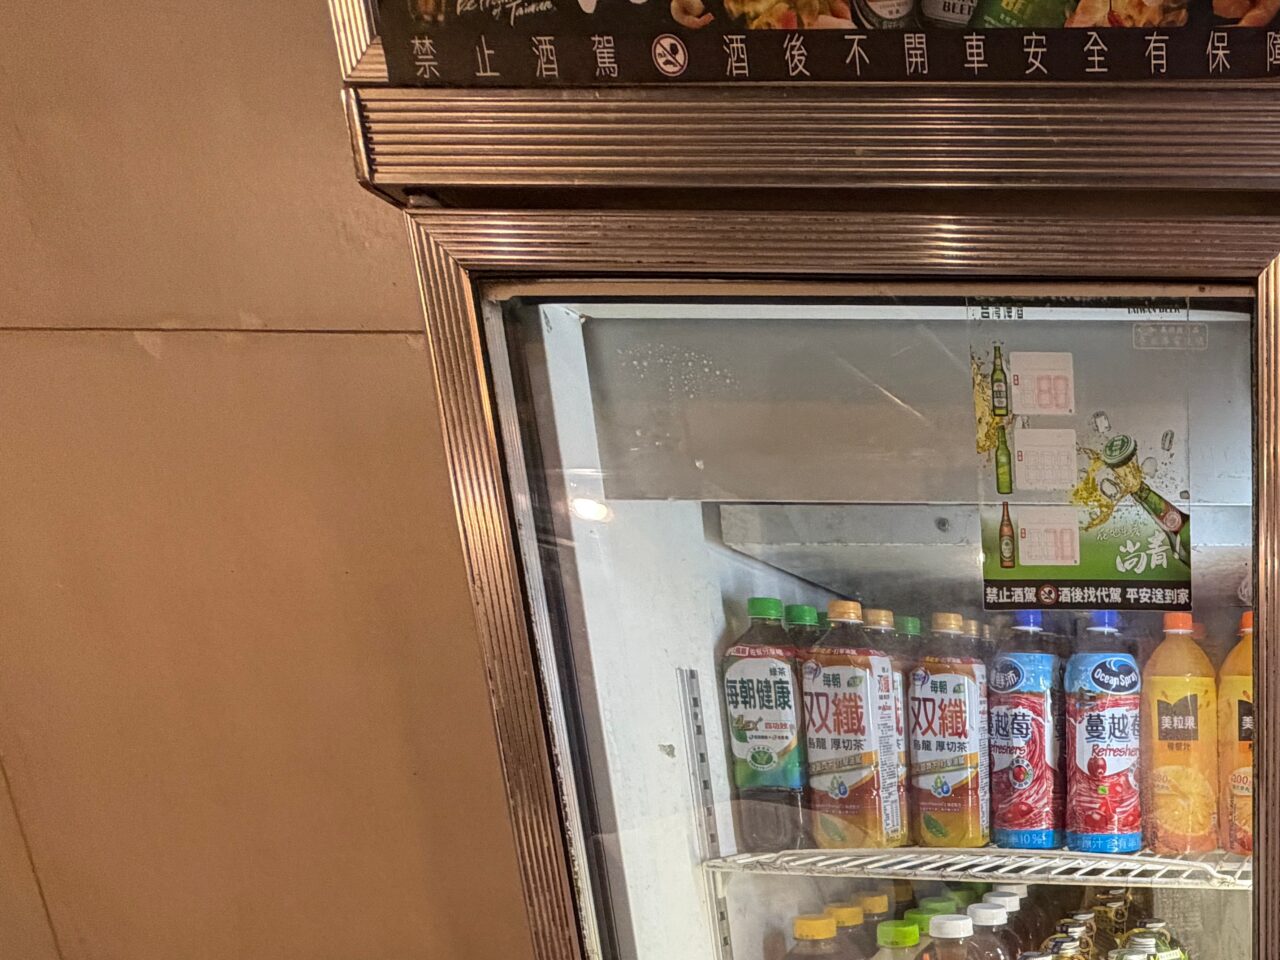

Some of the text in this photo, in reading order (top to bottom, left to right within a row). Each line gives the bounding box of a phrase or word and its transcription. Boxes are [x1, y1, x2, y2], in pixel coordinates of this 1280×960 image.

[410, 34, 619, 79] 禁止酒駕
[986, 586, 1189, 604] 禁止酒駕 酒後找代駕 平安送到家
[1094, 668, 1119, 687] Ocean
[726, 678, 792, 710] 每朝健康
[911, 697, 968, 739] 双纖
[1161, 716, 1196, 730] 美粒果
[936, 740, 968, 753] 厚切茶
